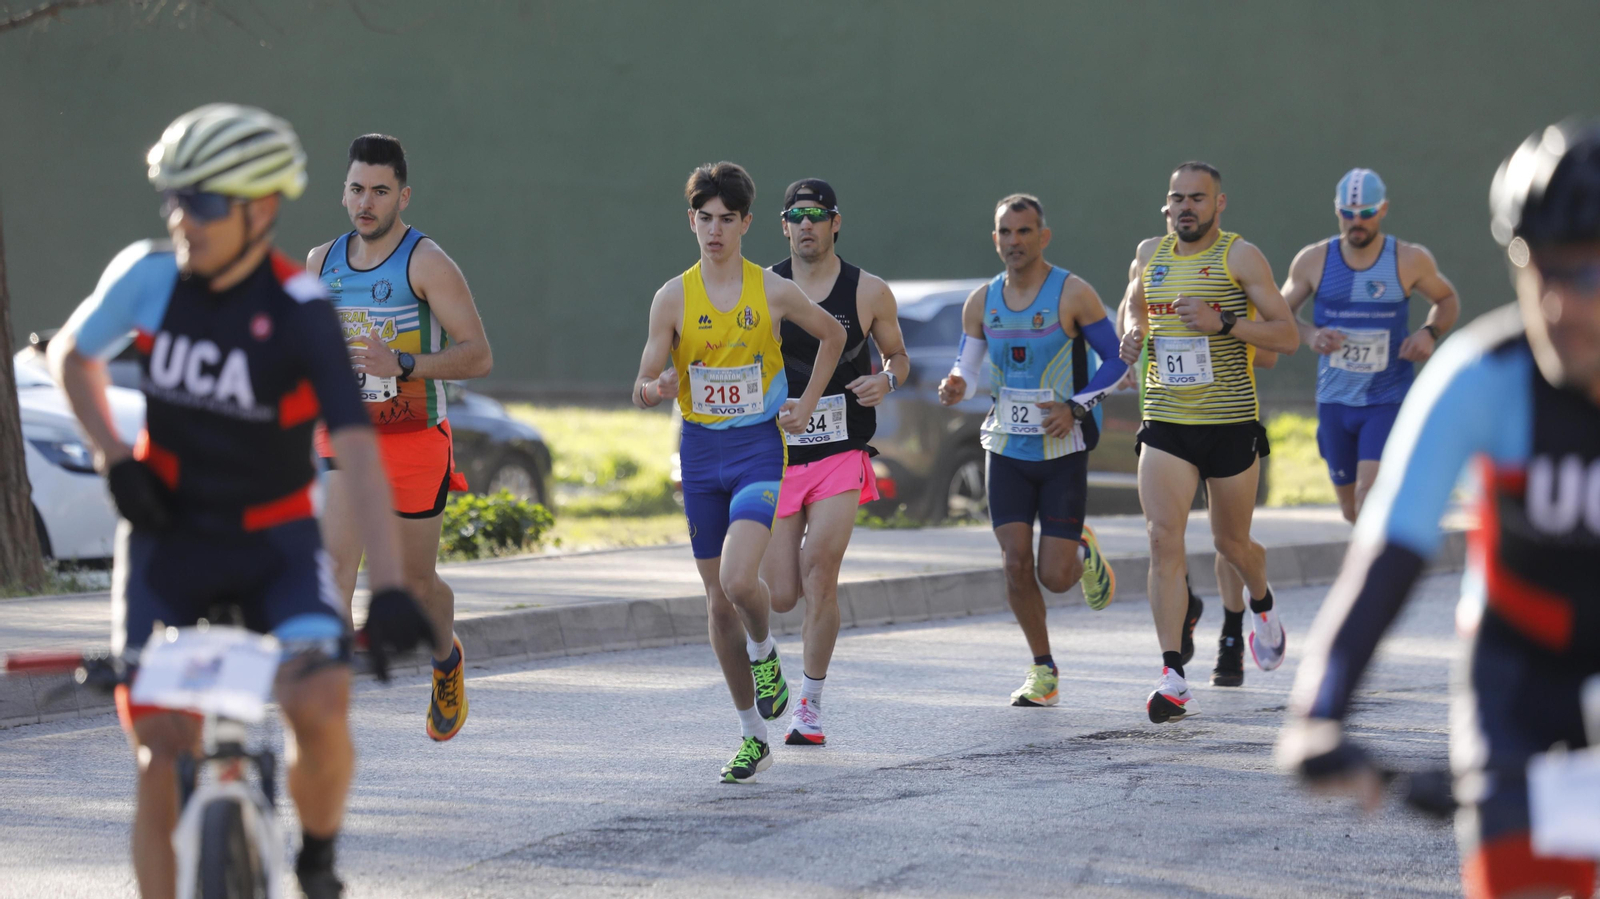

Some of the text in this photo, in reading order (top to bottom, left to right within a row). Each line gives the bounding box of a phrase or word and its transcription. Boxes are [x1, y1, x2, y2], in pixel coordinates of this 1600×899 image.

[1342, 344, 1371, 362] 237
[151, 330, 257, 411] UCA
[1166, 354, 1184, 373] 61
[703, 384, 741, 405] 218
[709, 407, 745, 415] EVOS
[1011, 405, 1029, 424] 82
[797, 434, 831, 443] EVOS
